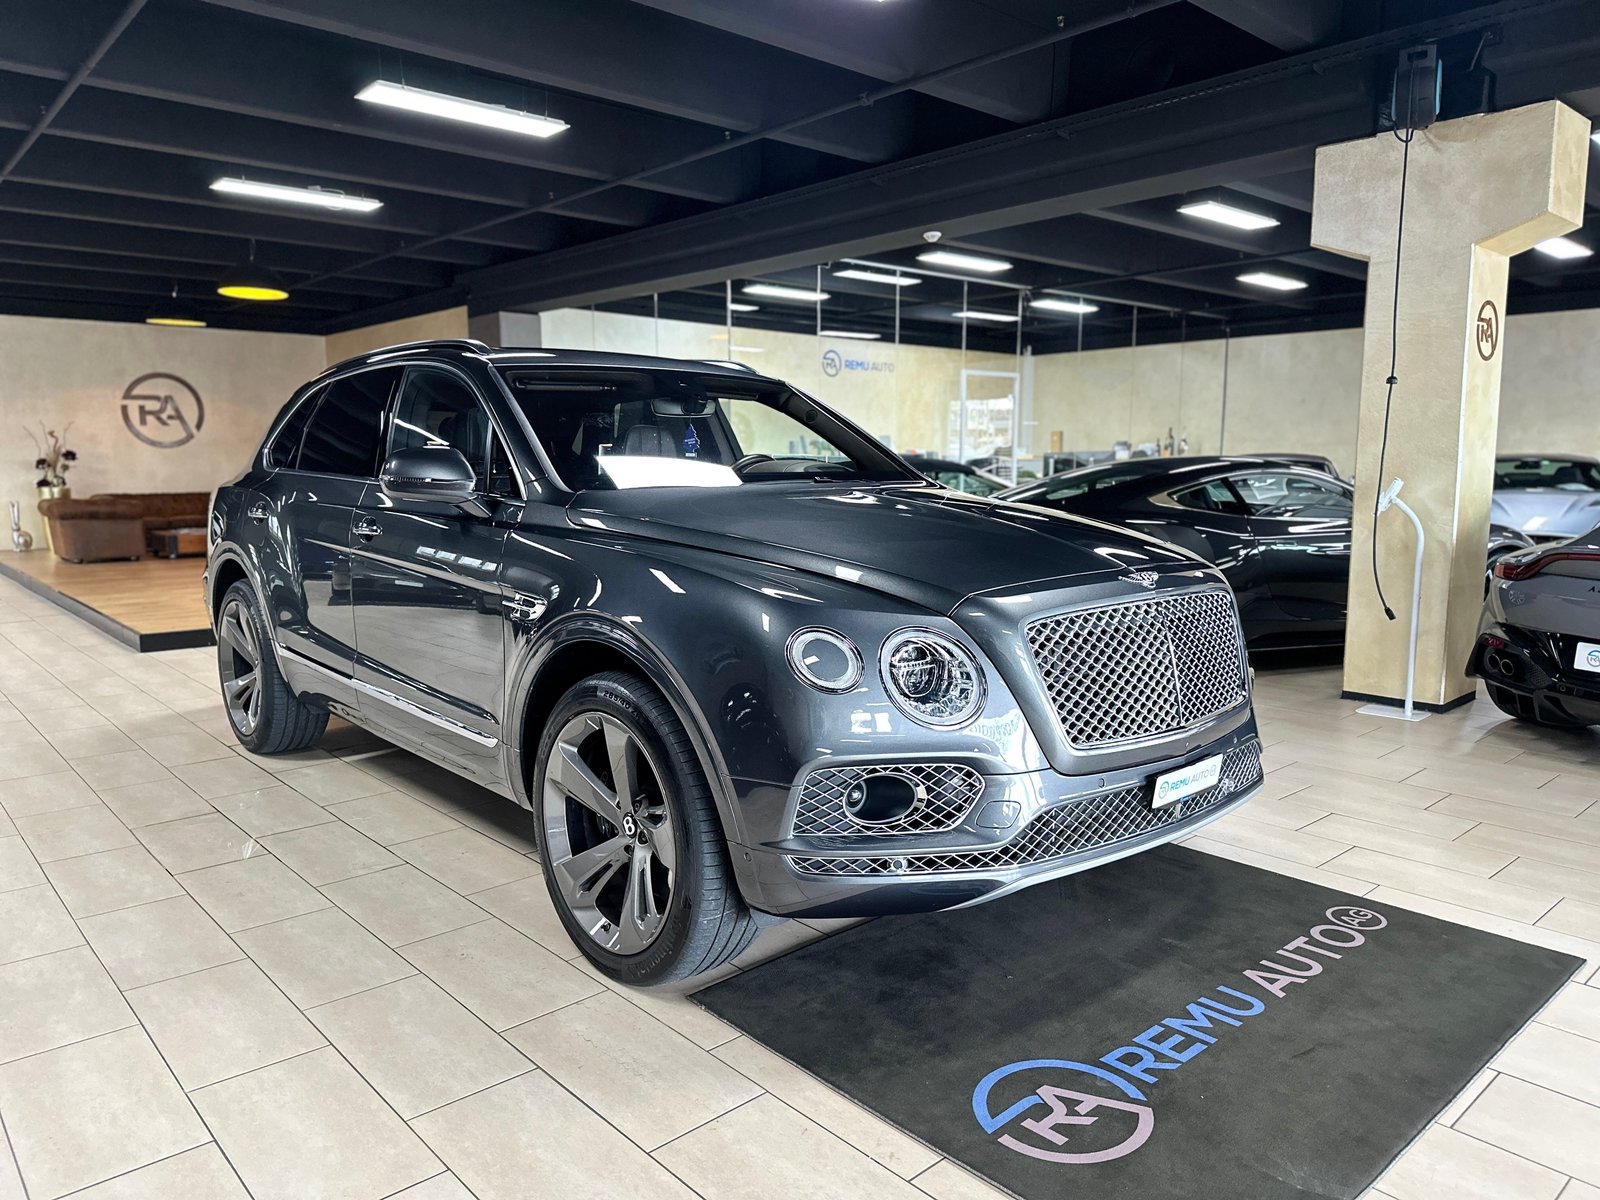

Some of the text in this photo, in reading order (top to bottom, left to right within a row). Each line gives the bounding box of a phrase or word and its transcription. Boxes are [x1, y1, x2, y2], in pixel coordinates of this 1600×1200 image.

[844, 360, 869, 371] REMU
[870, 362, 895, 373] AUTO
[1169, 776, 1191, 791] REMU
[1190, 769, 1210, 784] AUTO
[1099, 985, 1266, 1084] REMU
[1242, 924, 1366, 999] AUTO
